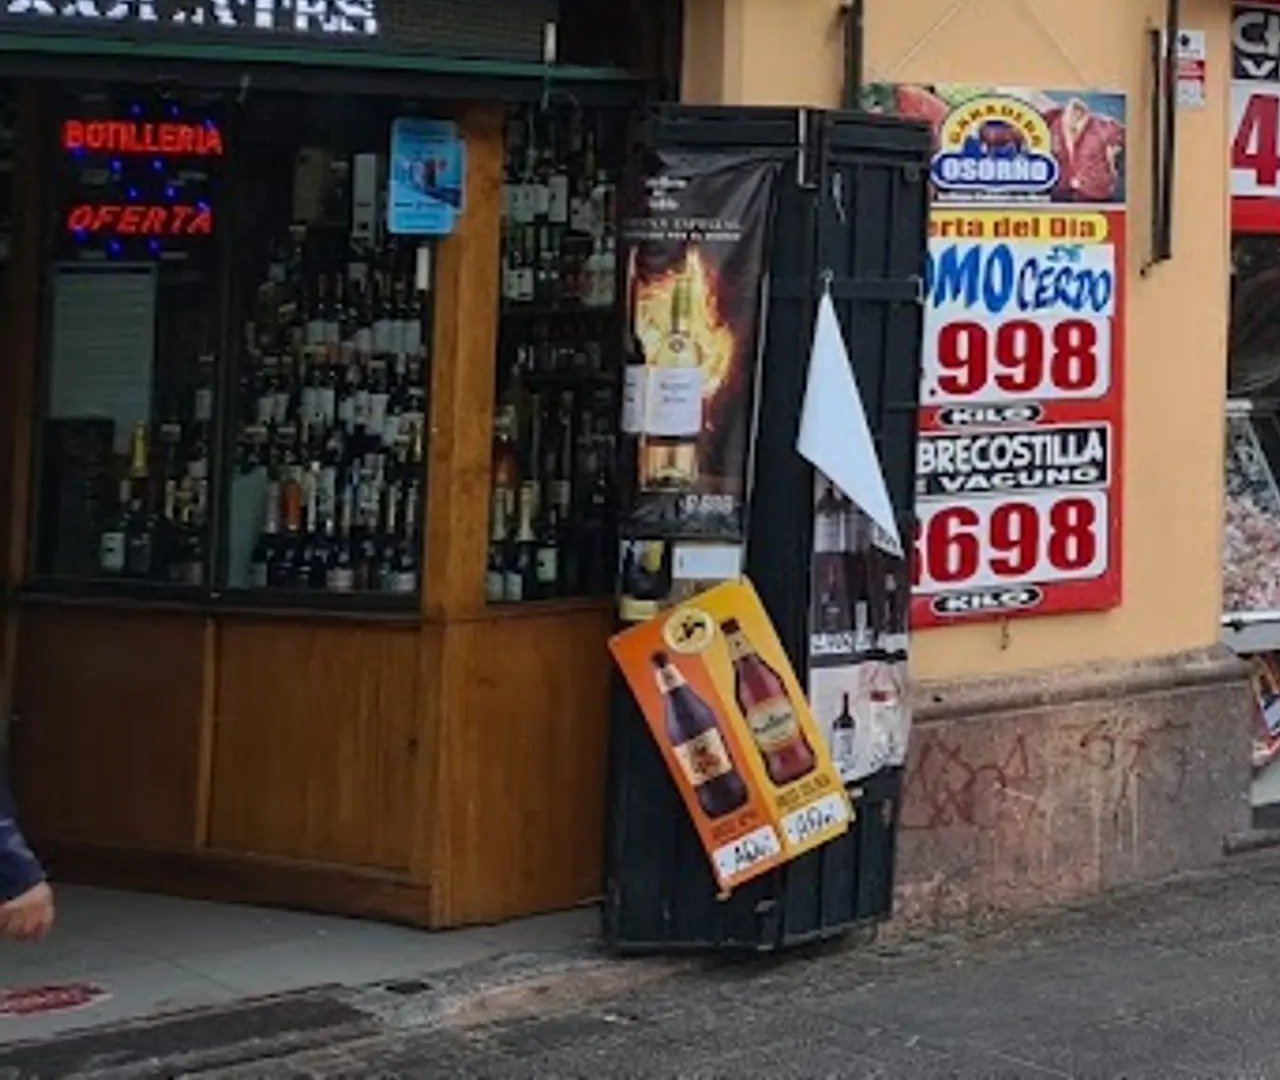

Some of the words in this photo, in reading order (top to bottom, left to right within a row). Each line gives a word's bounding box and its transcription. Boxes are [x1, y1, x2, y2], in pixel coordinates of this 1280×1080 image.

[64, 120, 223, 155] BOTILLERIA
[68, 205, 212, 234] OFERTA
[993, 216, 1040, 238] del
[951, 408, 1033, 424] KILO
[917, 430, 1104, 474] BRECOSTILLA
[938, 469, 1100, 492] VACUNO
[945, 590, 1030, 609] KILO
